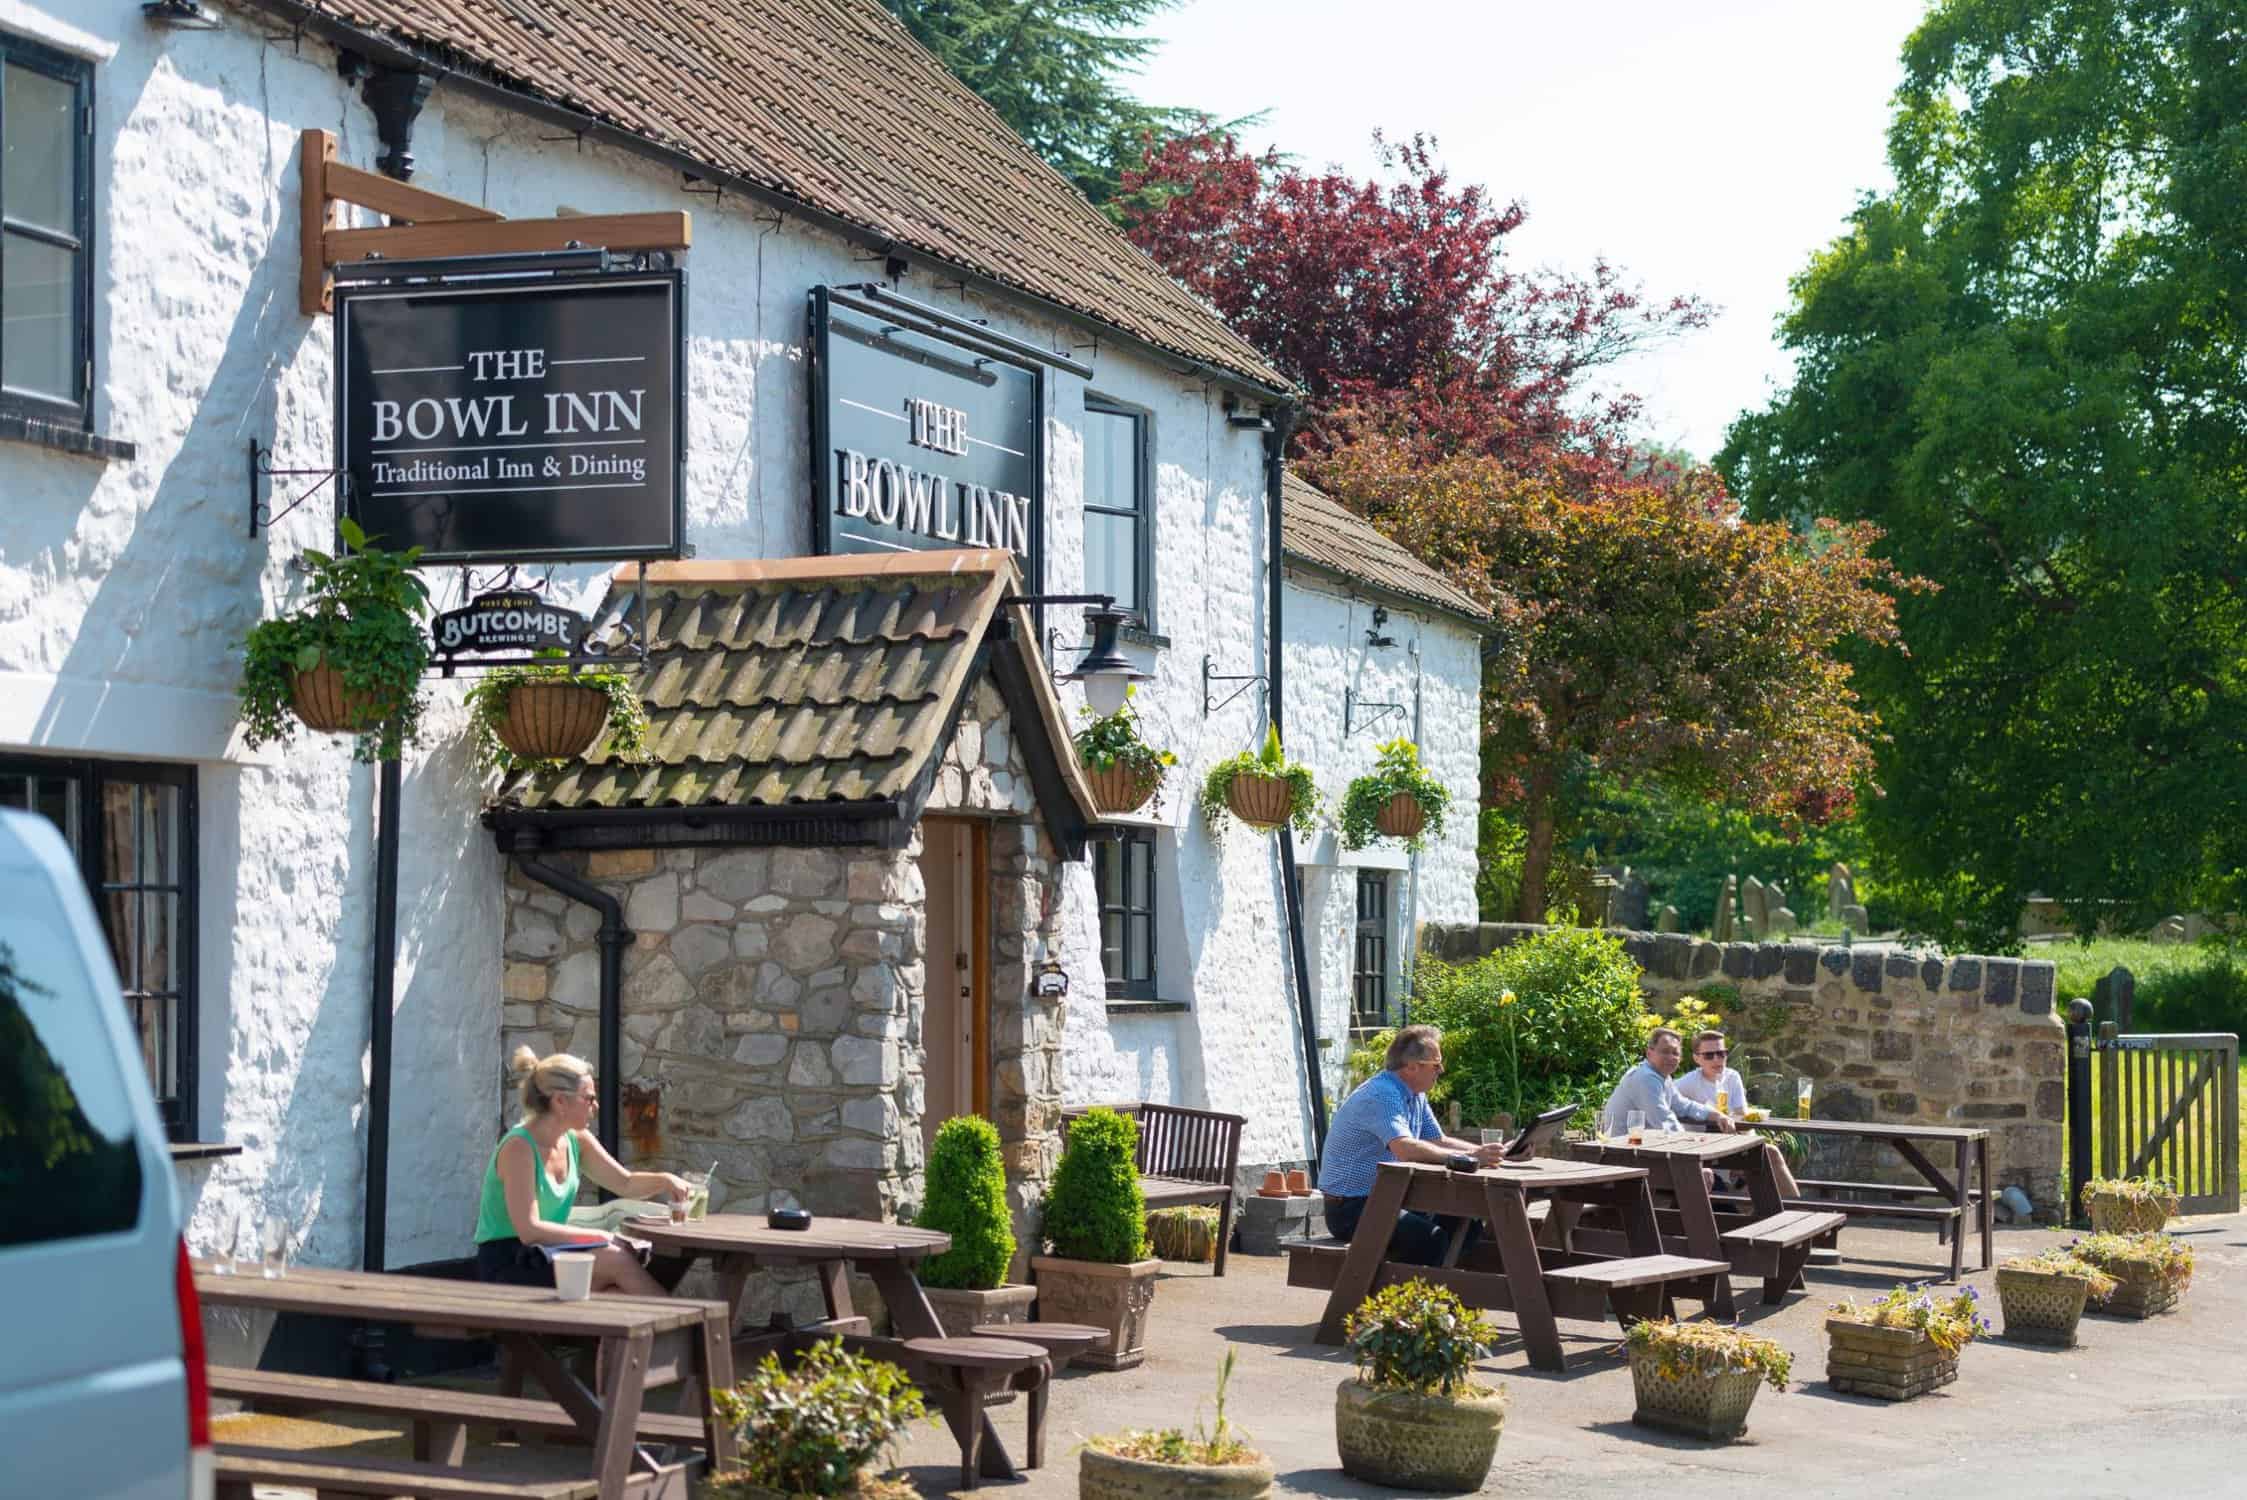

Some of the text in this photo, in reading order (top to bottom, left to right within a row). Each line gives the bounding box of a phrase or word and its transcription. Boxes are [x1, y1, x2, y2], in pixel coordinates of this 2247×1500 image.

[468, 349, 546, 381] THE
[371, 389, 646, 442] BOWL INN
[912, 396, 969, 457] THE
[371, 453, 646, 484] Traditional Inn & Dining
[845, 447, 1031, 558] BOWL INN
[440, 610, 572, 647] BUTCOMBE
[479, 633, 525, 643] BREWING
